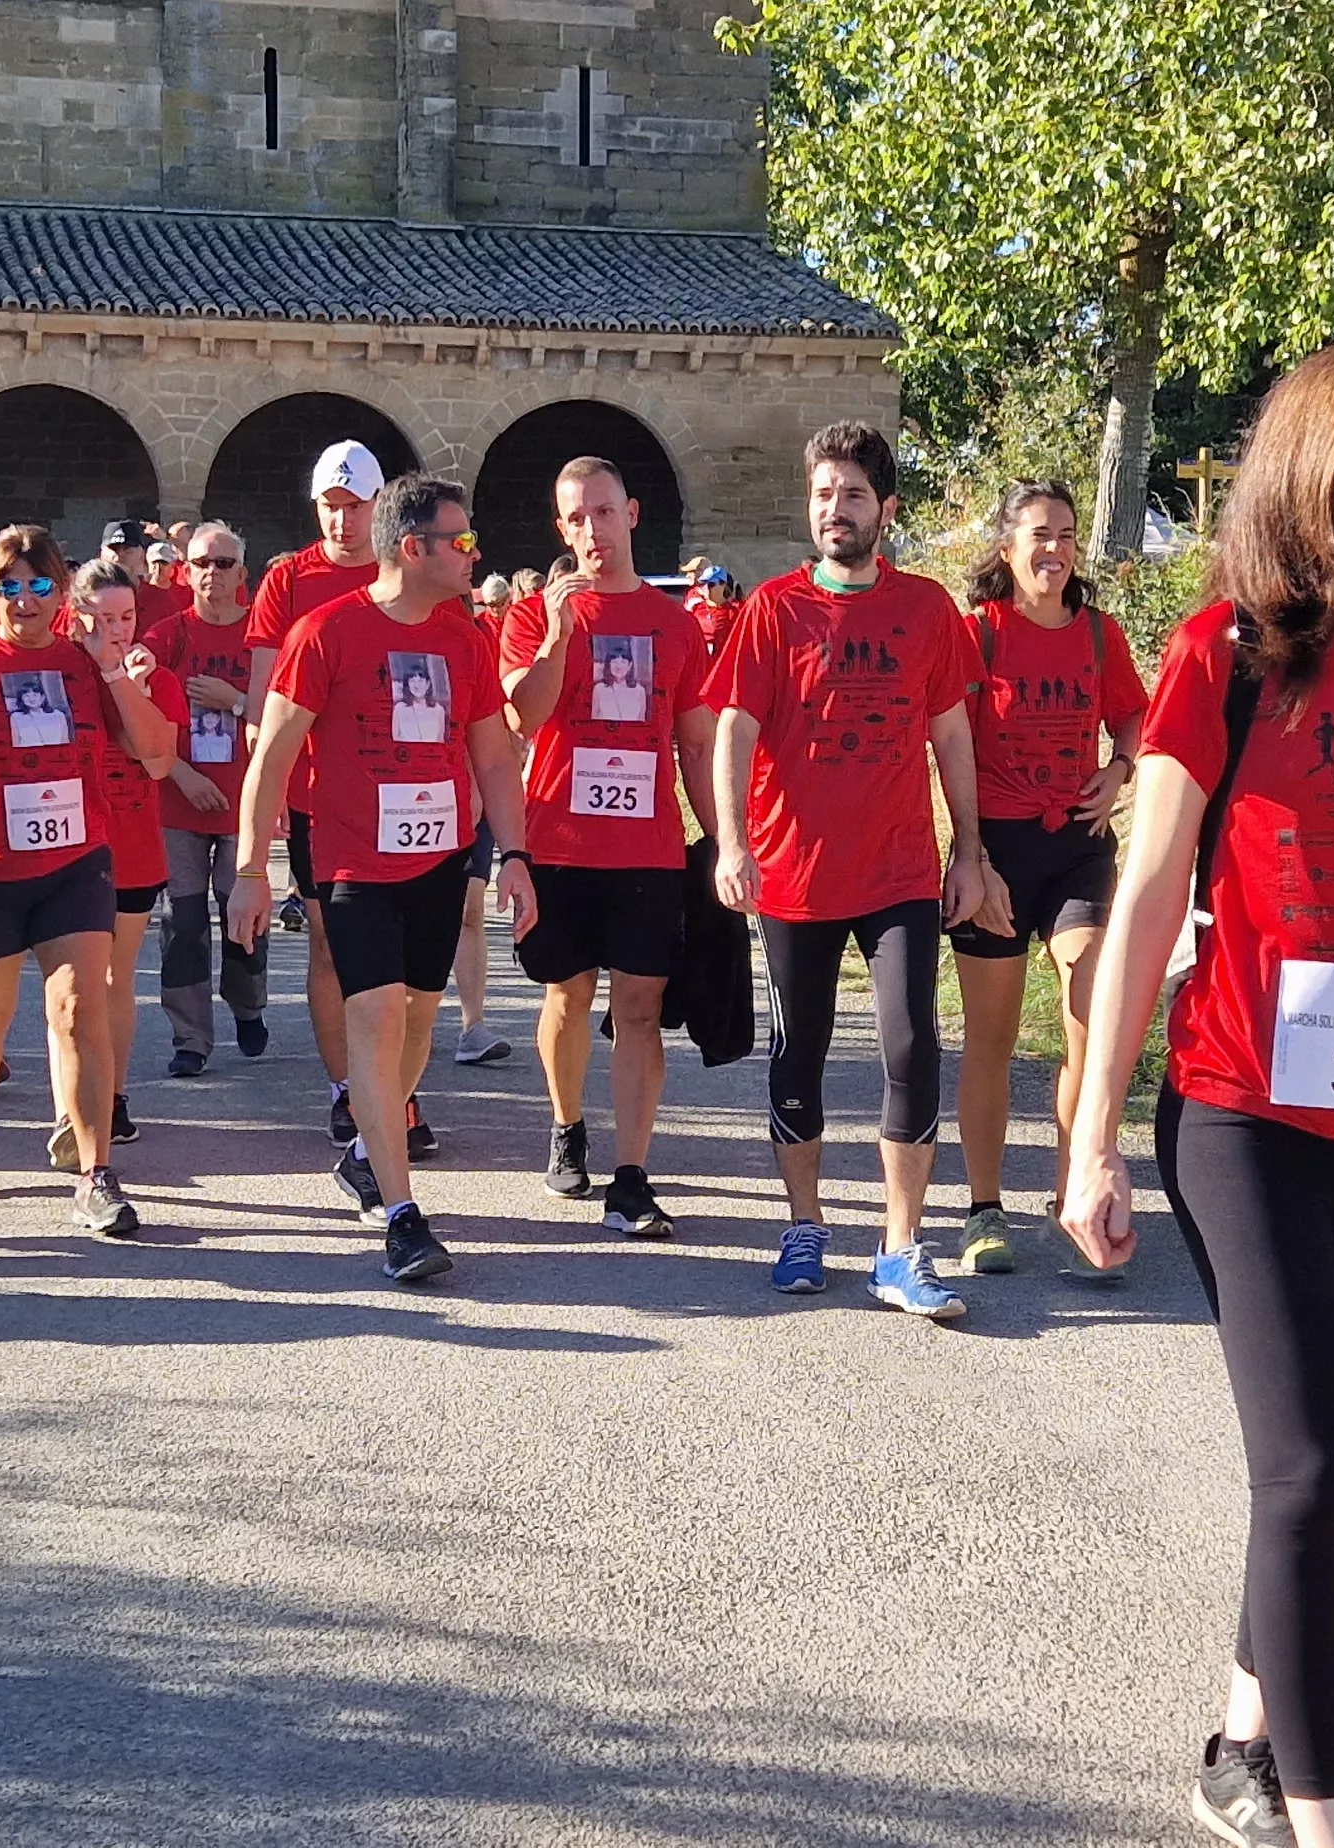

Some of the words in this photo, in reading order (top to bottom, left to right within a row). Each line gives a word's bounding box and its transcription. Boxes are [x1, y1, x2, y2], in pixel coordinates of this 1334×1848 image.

[588, 784, 637, 811] 325
[26, 816, 69, 844] 381
[397, 820, 445, 847] 327
